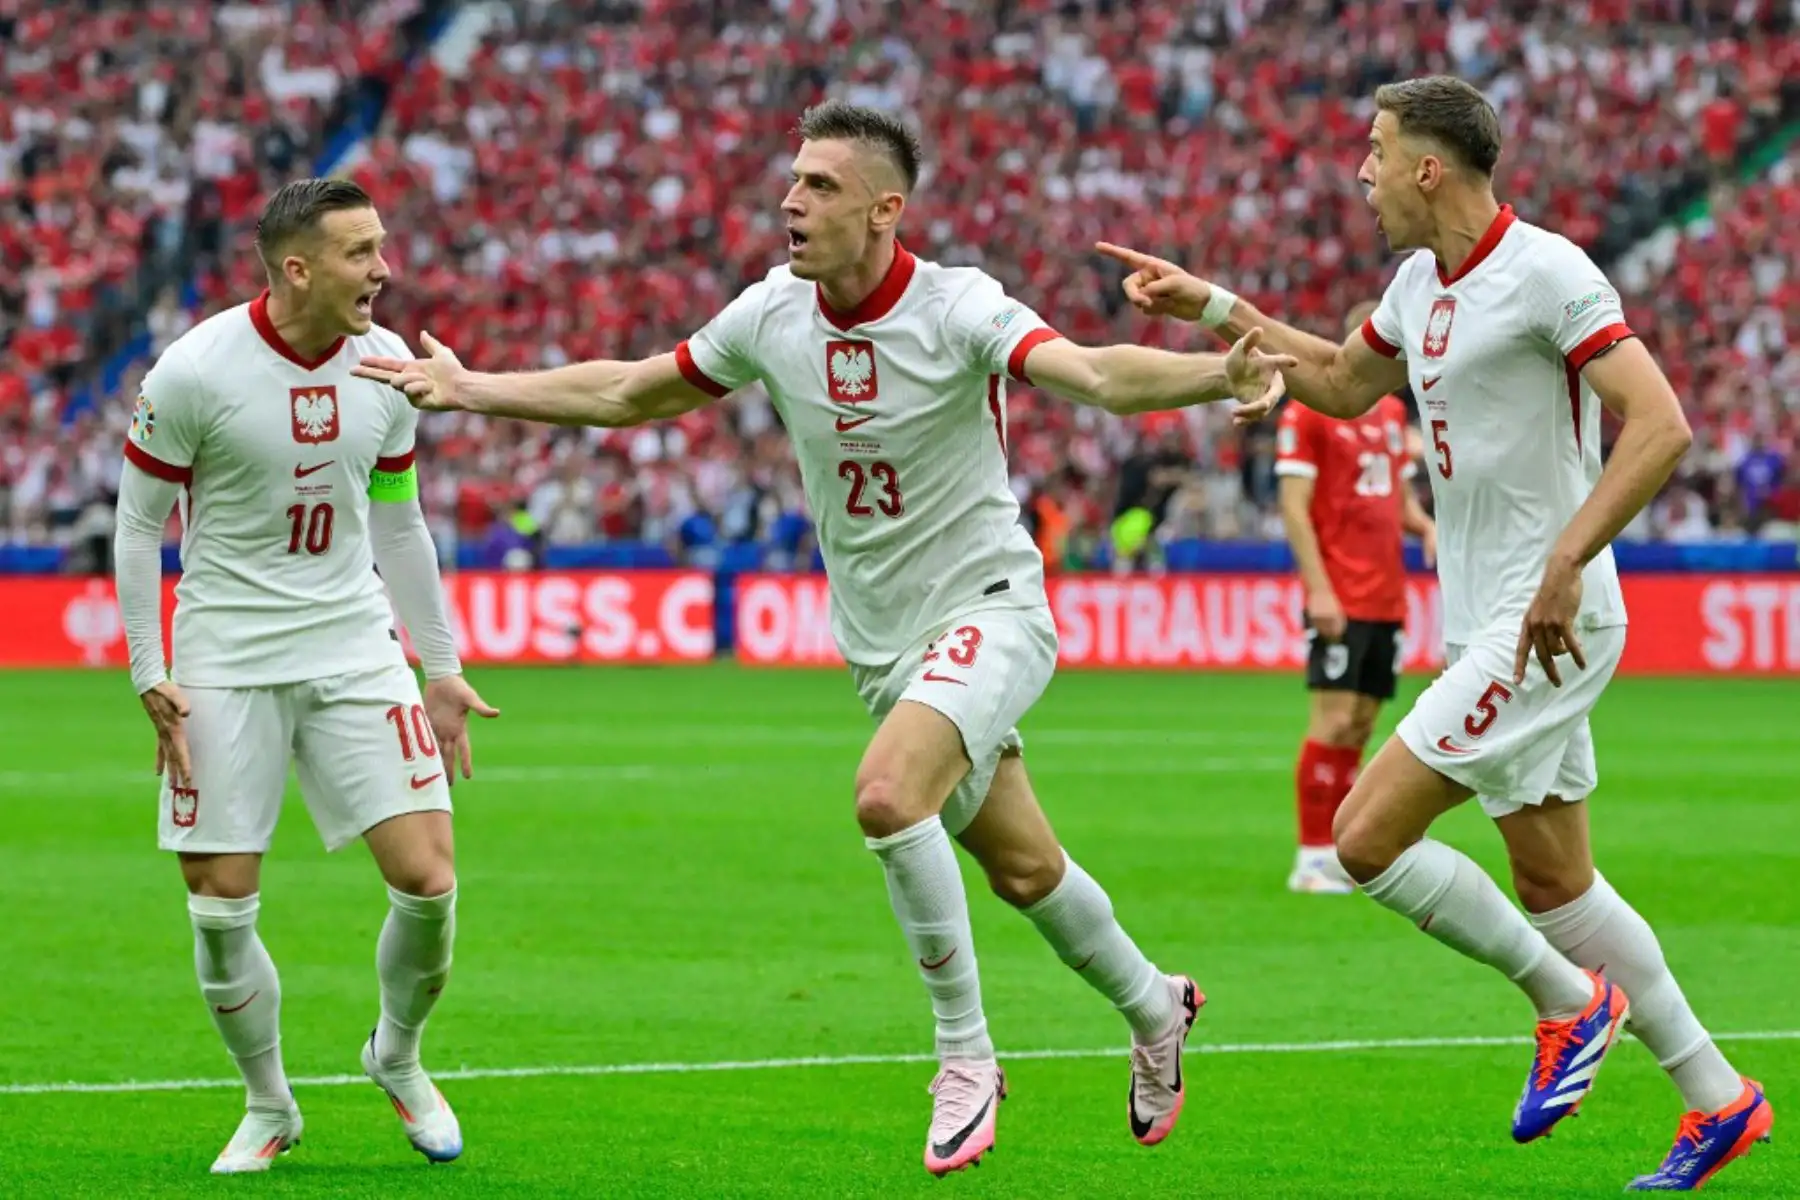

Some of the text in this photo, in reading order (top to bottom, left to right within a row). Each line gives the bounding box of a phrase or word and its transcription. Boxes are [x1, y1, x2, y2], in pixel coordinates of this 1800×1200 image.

[1355, 451, 1392, 497] 20
[1431, 419, 1453, 480] 5
[838, 460, 905, 519] 23
[286, 502, 334, 557] 10
[386, 704, 437, 761] 10
[1464, 680, 1513, 740] 5
